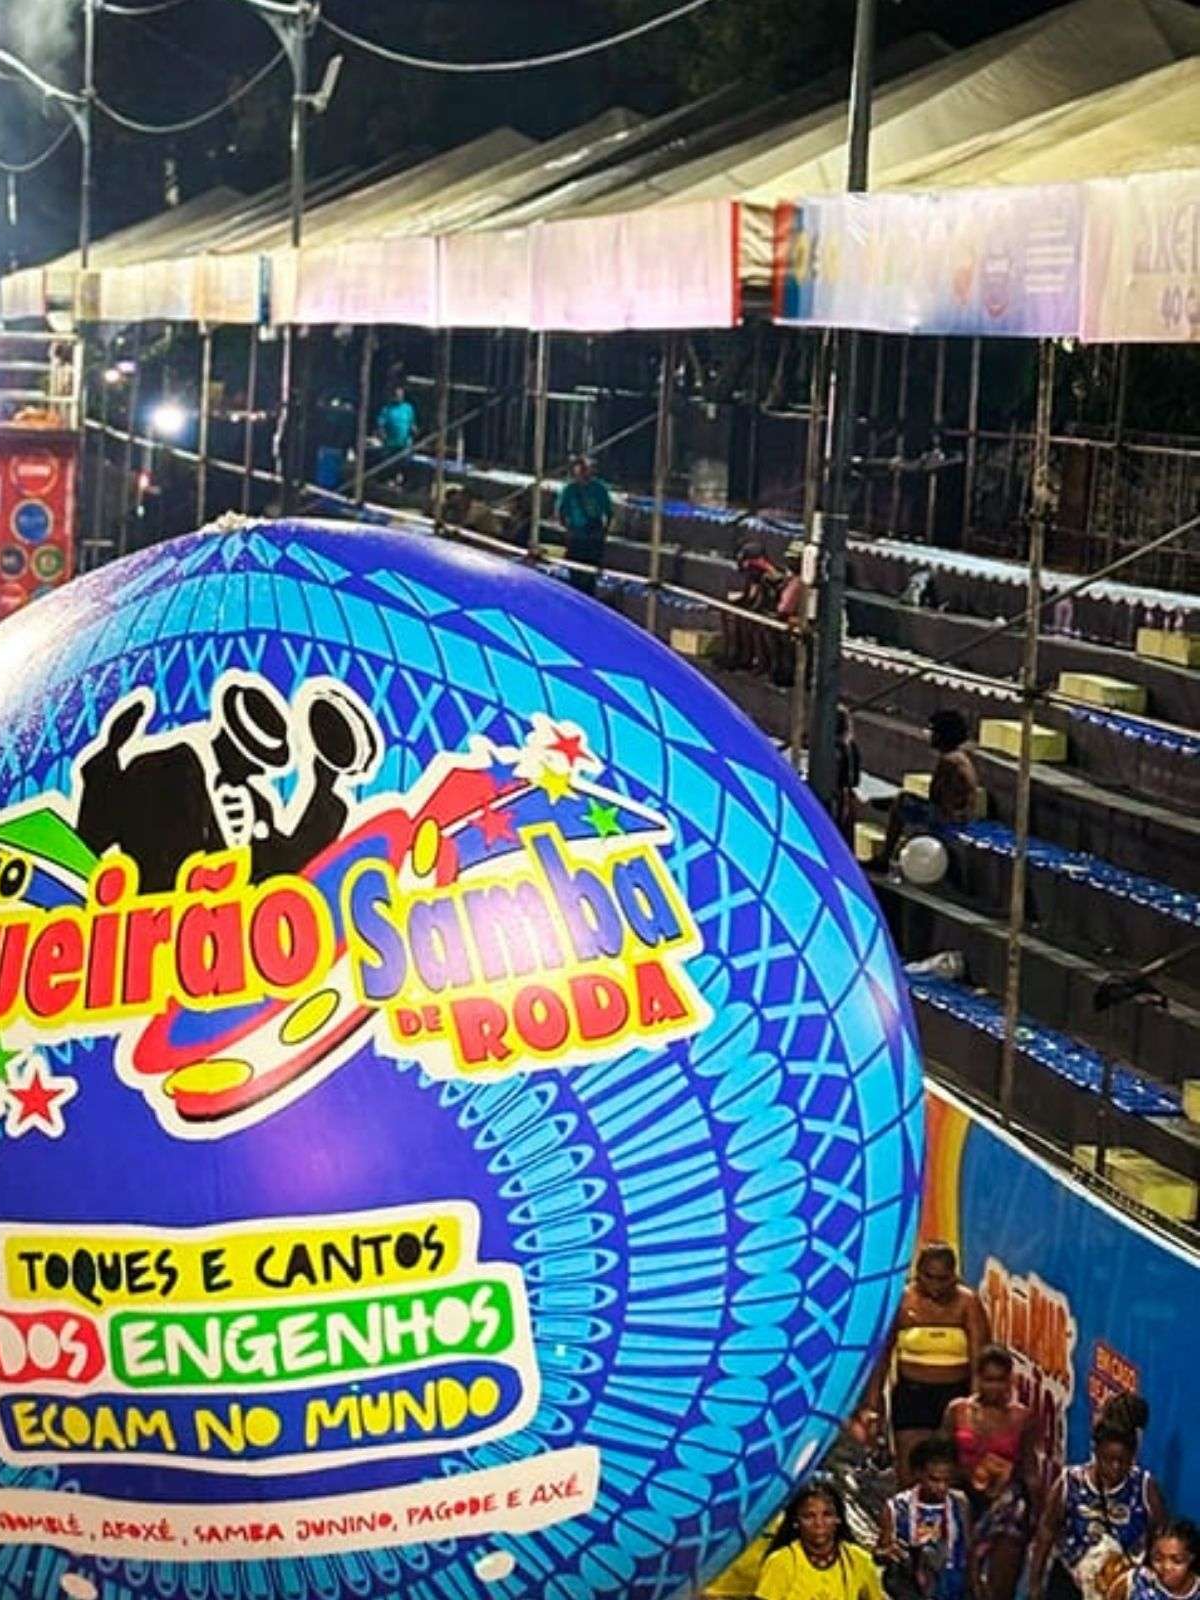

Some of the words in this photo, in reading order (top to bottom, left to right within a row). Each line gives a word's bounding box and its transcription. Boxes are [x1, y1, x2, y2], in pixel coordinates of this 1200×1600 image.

[351, 834, 683, 1000] Samba
[396, 1006, 443, 1037] DE
[450, 961, 688, 1065] RODA
[18, 1247, 178, 1305] TOQUES
[202, 1247, 232, 1293] E
[255, 1223, 446, 1289] CANTOS
[120, 1284, 501, 1381] ENGENHOS
[11, 1400, 177, 1452] ECOAM
[198, 1404, 282, 1453] NO
[306, 1376, 501, 1447] MUNDO
[194, 1523, 283, 1543] SAMBA
[407, 1494, 498, 1526] PAGODE
[506, 1488, 522, 1509] E
[530, 1473, 583, 1507] AXÉ
